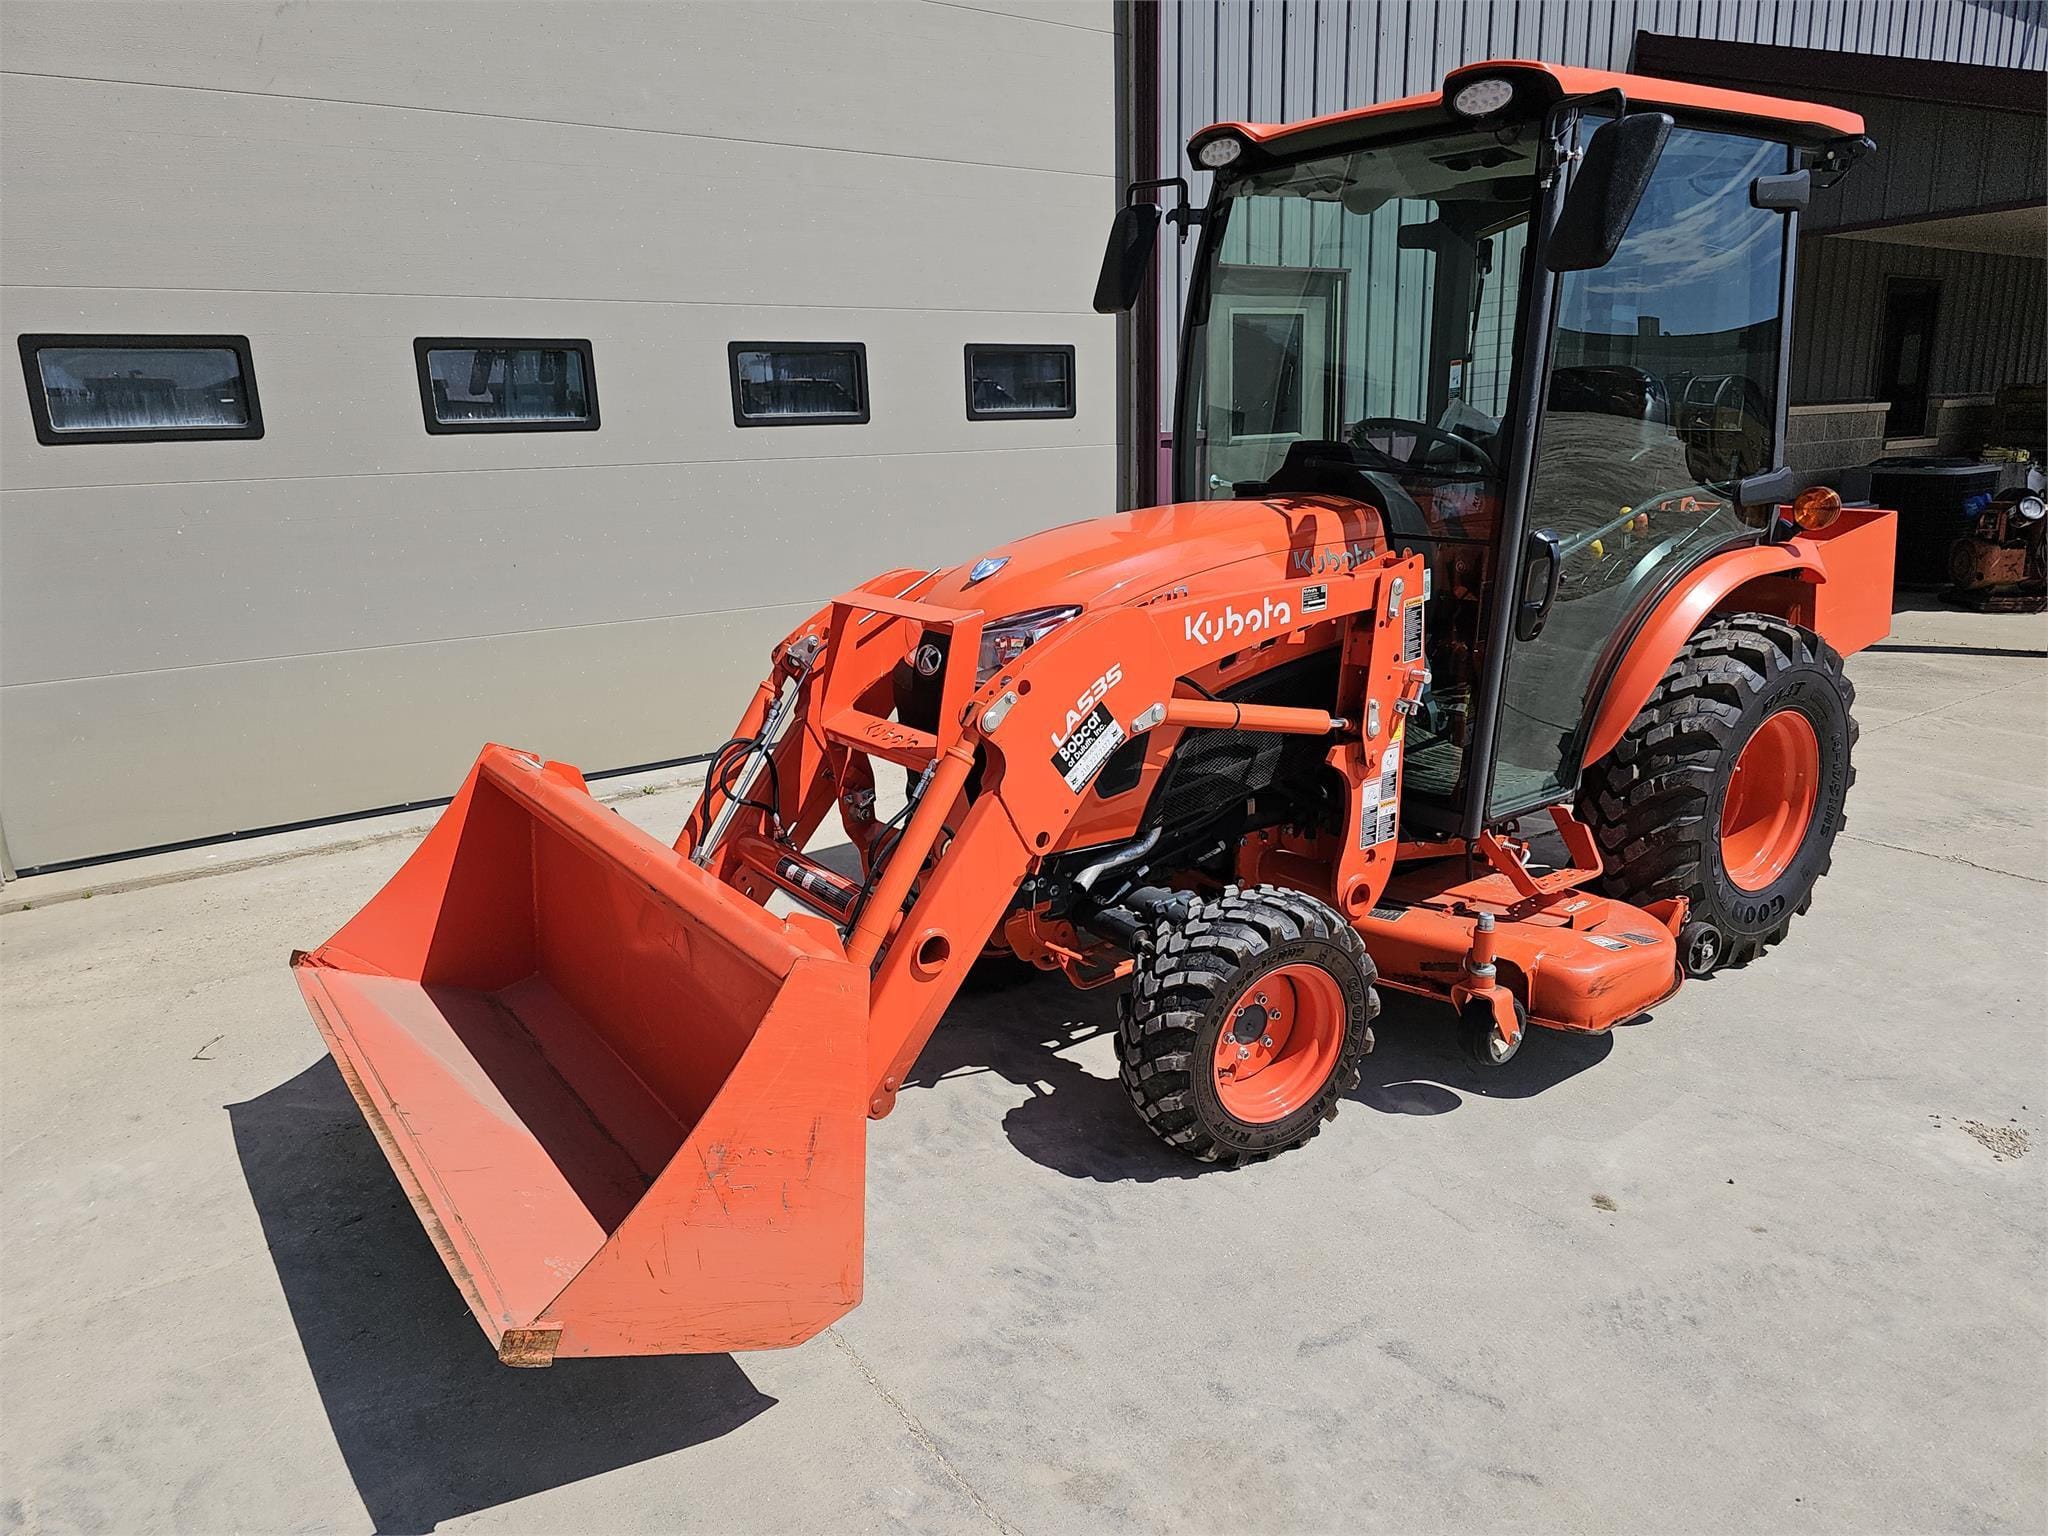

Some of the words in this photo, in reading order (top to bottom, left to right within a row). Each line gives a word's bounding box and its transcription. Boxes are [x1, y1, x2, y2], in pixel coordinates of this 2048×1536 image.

[1293, 543, 1377, 574] Kubota
[1185, 596, 1291, 645] Kubota
[1050, 661, 1123, 749] LA535
[1059, 711, 1102, 761] Bobcat
[1068, 754, 1076, 768] of
[1074, 737, 1096, 760] Duluth,
[1093, 723, 1107, 739] Inc.
